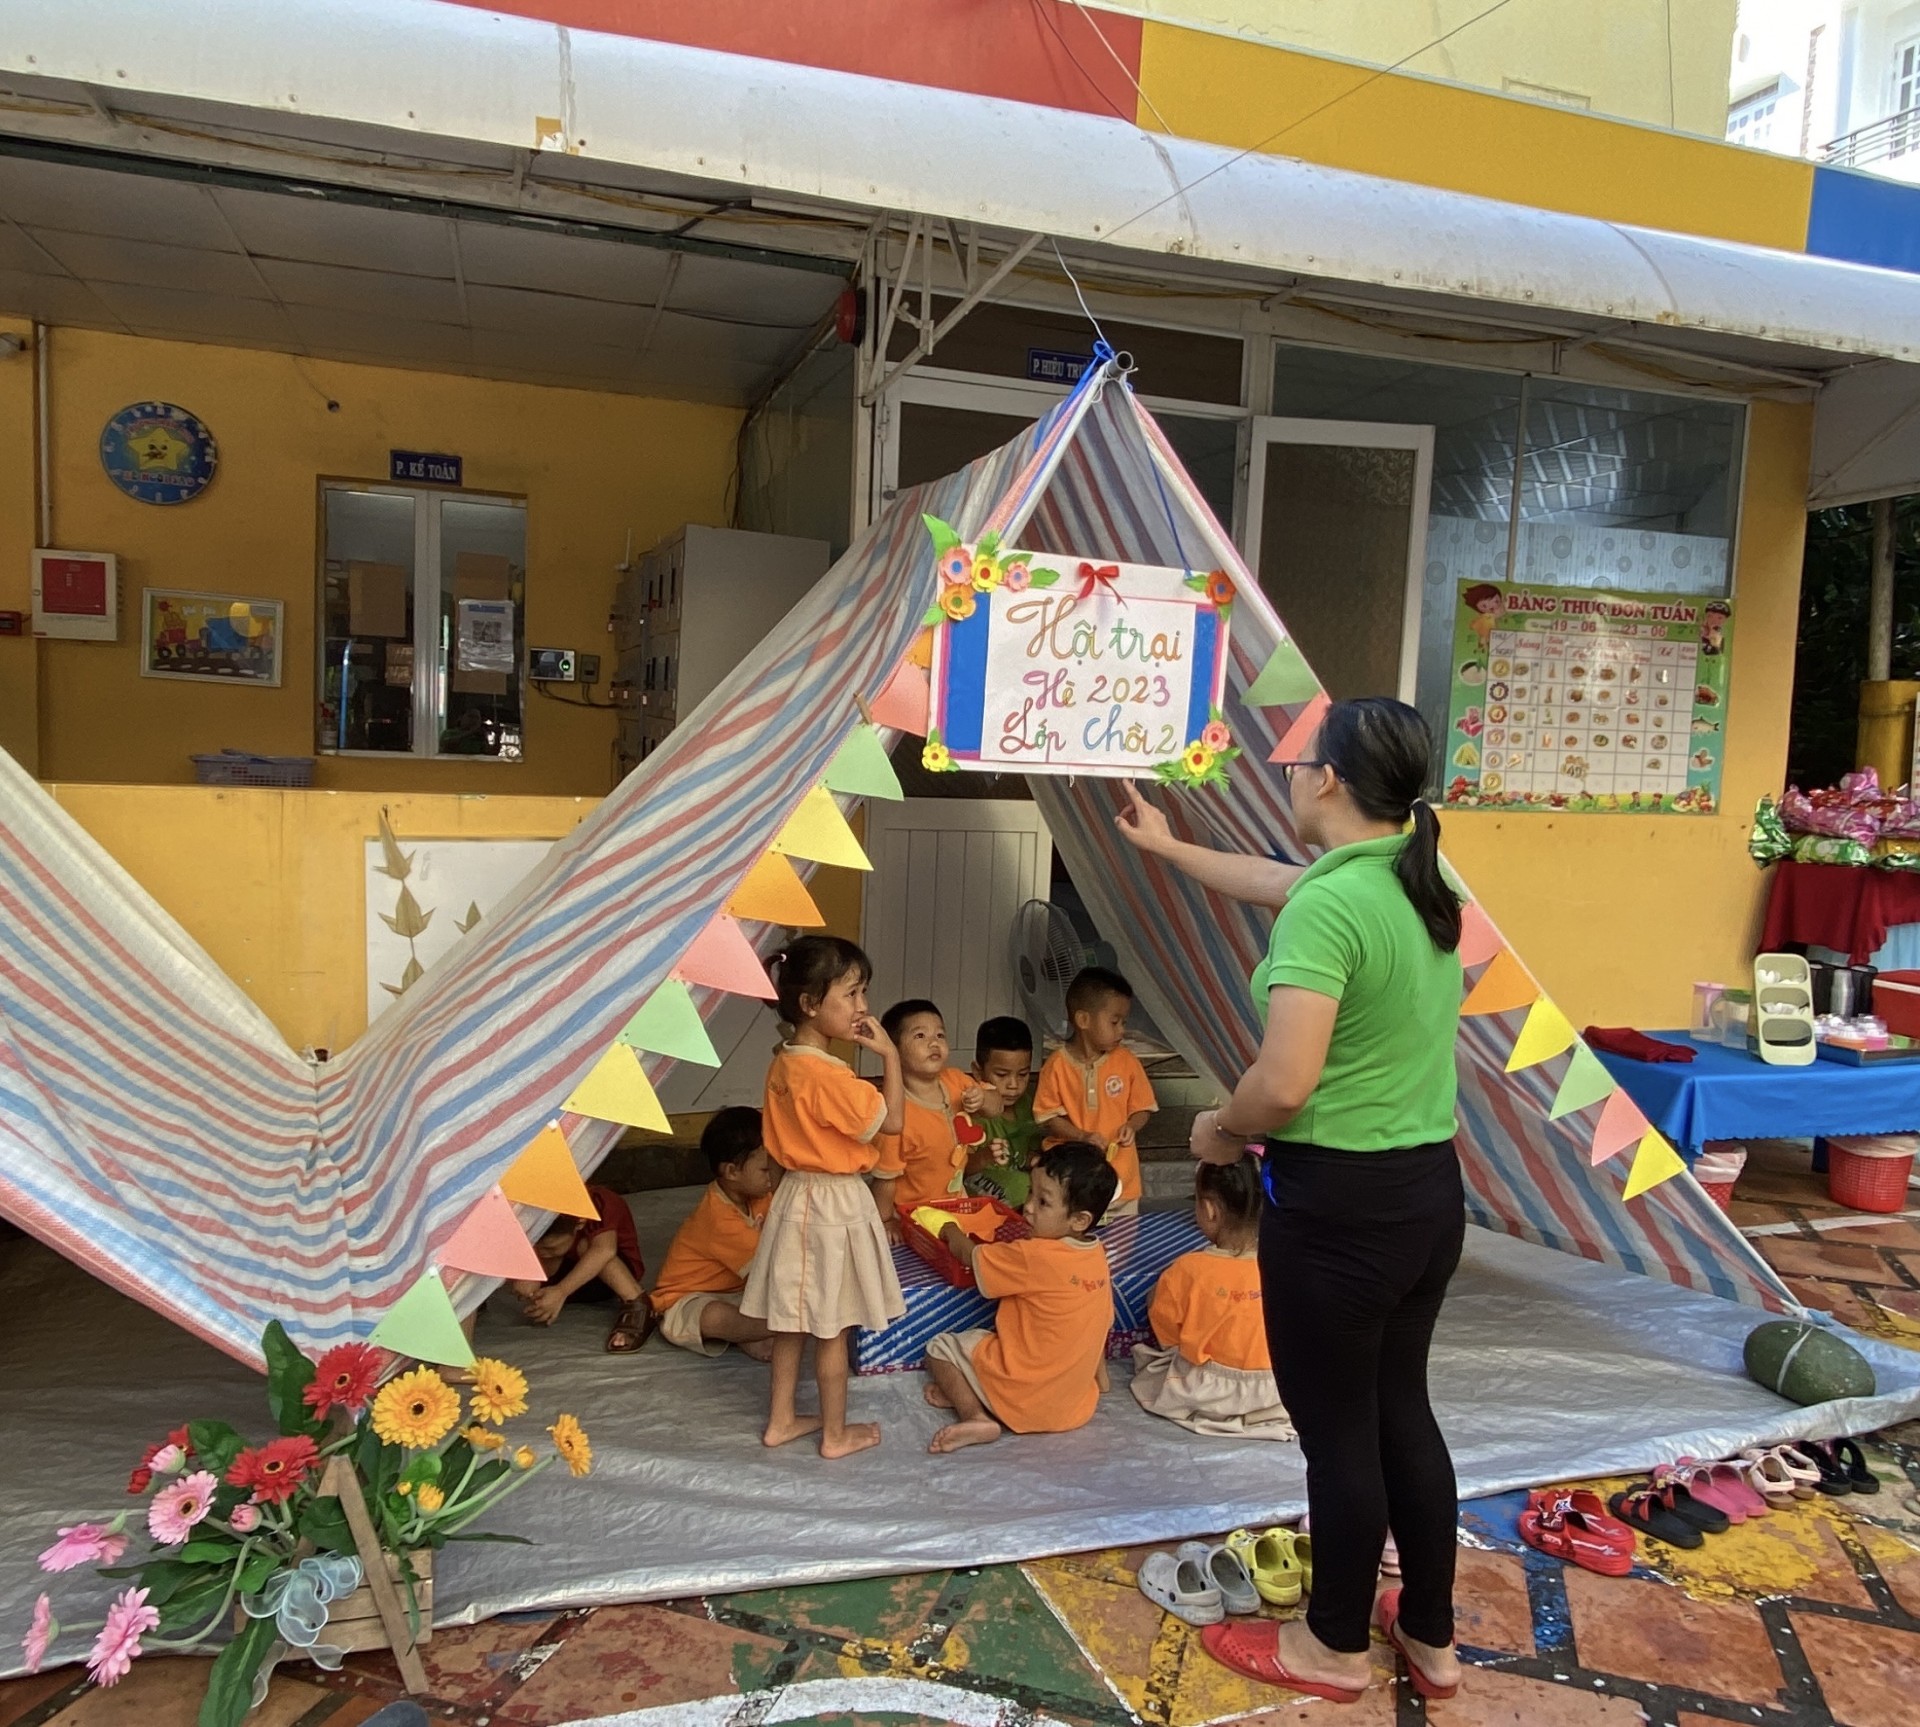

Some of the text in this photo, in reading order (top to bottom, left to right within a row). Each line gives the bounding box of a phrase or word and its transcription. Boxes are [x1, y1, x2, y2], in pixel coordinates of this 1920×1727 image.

[1041, 356, 1065, 379] HIỆU
[396, 457, 457, 480] P. KẾ TOÁN
[1507, 589, 1558, 613] BẢNG
[1006, 594, 1182, 668] Hội trại
[1553, 619, 1568, 632] 19
[1581, 620, 1597, 633] 06
[1621, 624, 1638, 636] 23
[1650, 625, 1666, 638] 06
[1022, 667, 1171, 710] Hè 2023
[999, 697, 1066, 763] Lớp
[1154, 724, 1178, 755] 2
